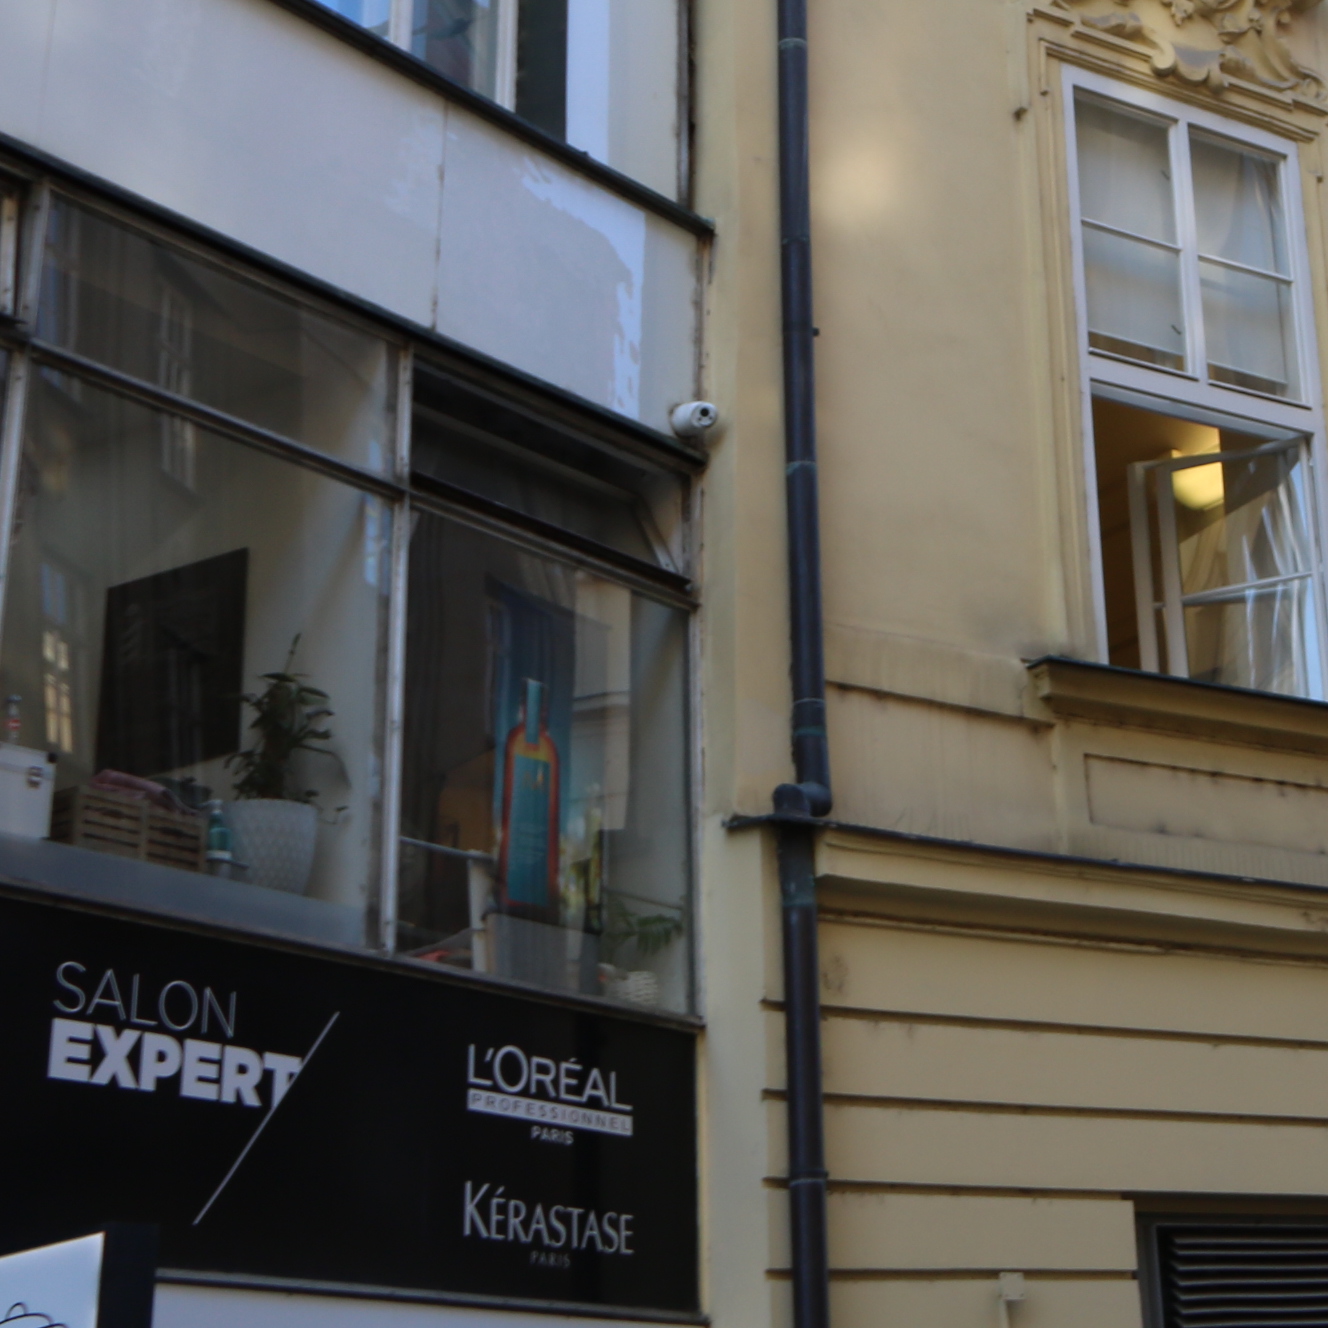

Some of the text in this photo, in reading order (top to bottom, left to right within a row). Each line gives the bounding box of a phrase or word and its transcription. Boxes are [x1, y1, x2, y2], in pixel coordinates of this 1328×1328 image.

[52, 960, 238, 1039] SALON
[46, 1016, 304, 1111] EXPERT
[468, 1091, 632, 1134] PROFESSIONNEL
[529, 1124, 575, 1146] PARIS
[463, 1179, 635, 1256] KÉRASTASE
[529, 1249, 572, 1270] PARIS
